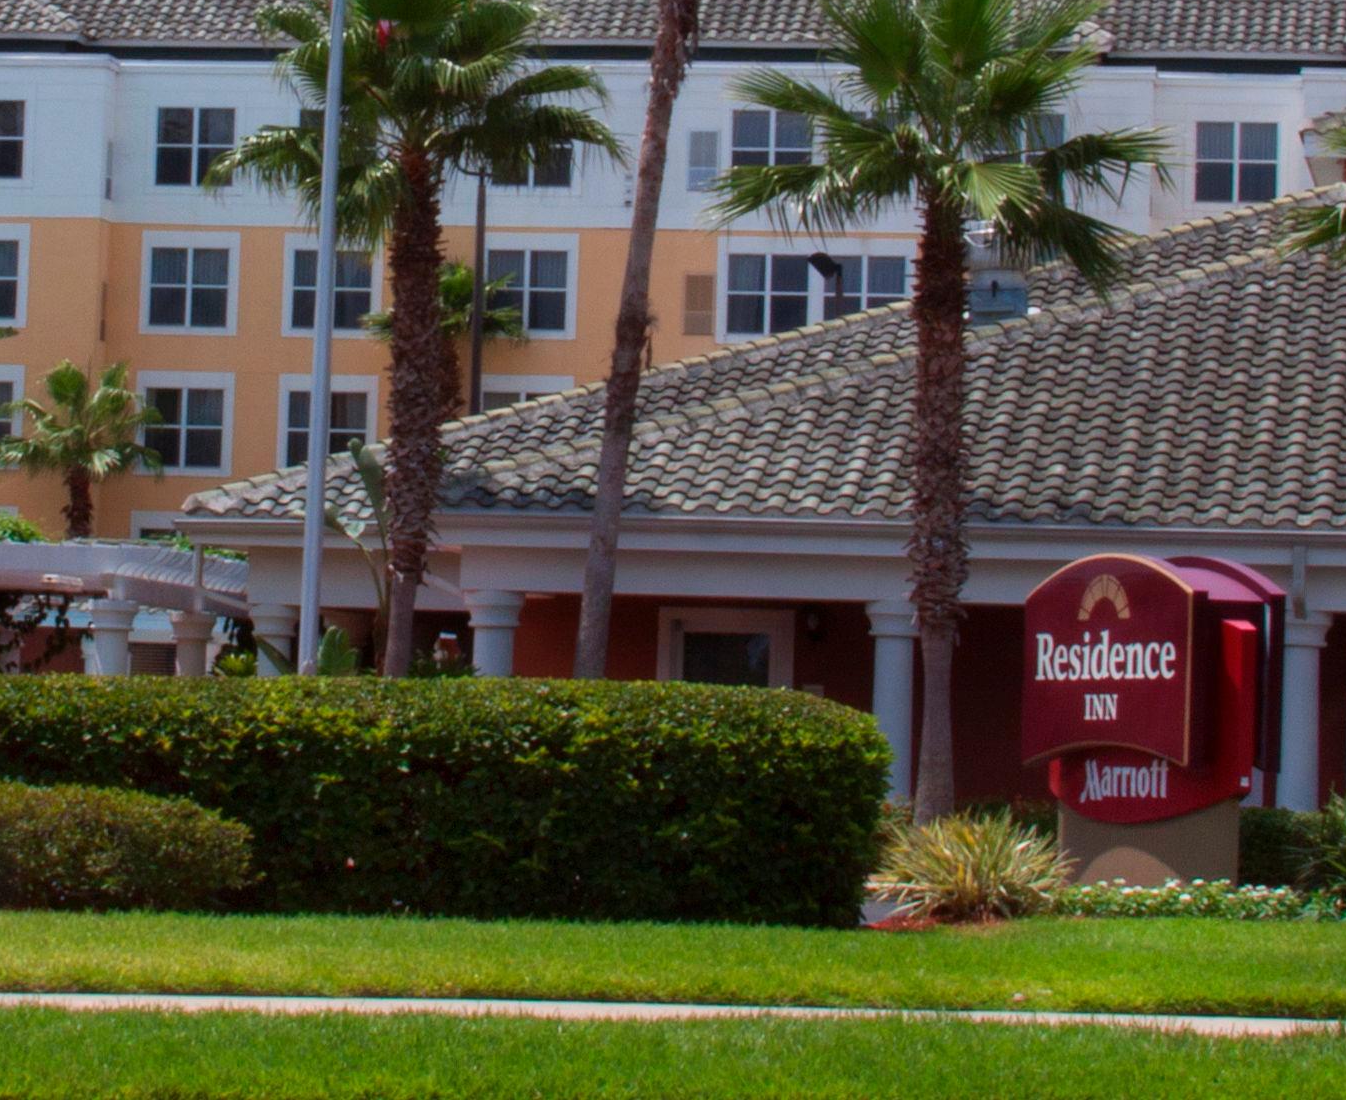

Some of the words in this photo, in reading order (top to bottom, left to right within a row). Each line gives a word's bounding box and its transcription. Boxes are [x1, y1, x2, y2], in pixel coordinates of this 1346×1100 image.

[1035, 629, 1176, 681] Residence
[1083, 694, 1118, 721] INN
[1080, 759, 1169, 803] Marriott
